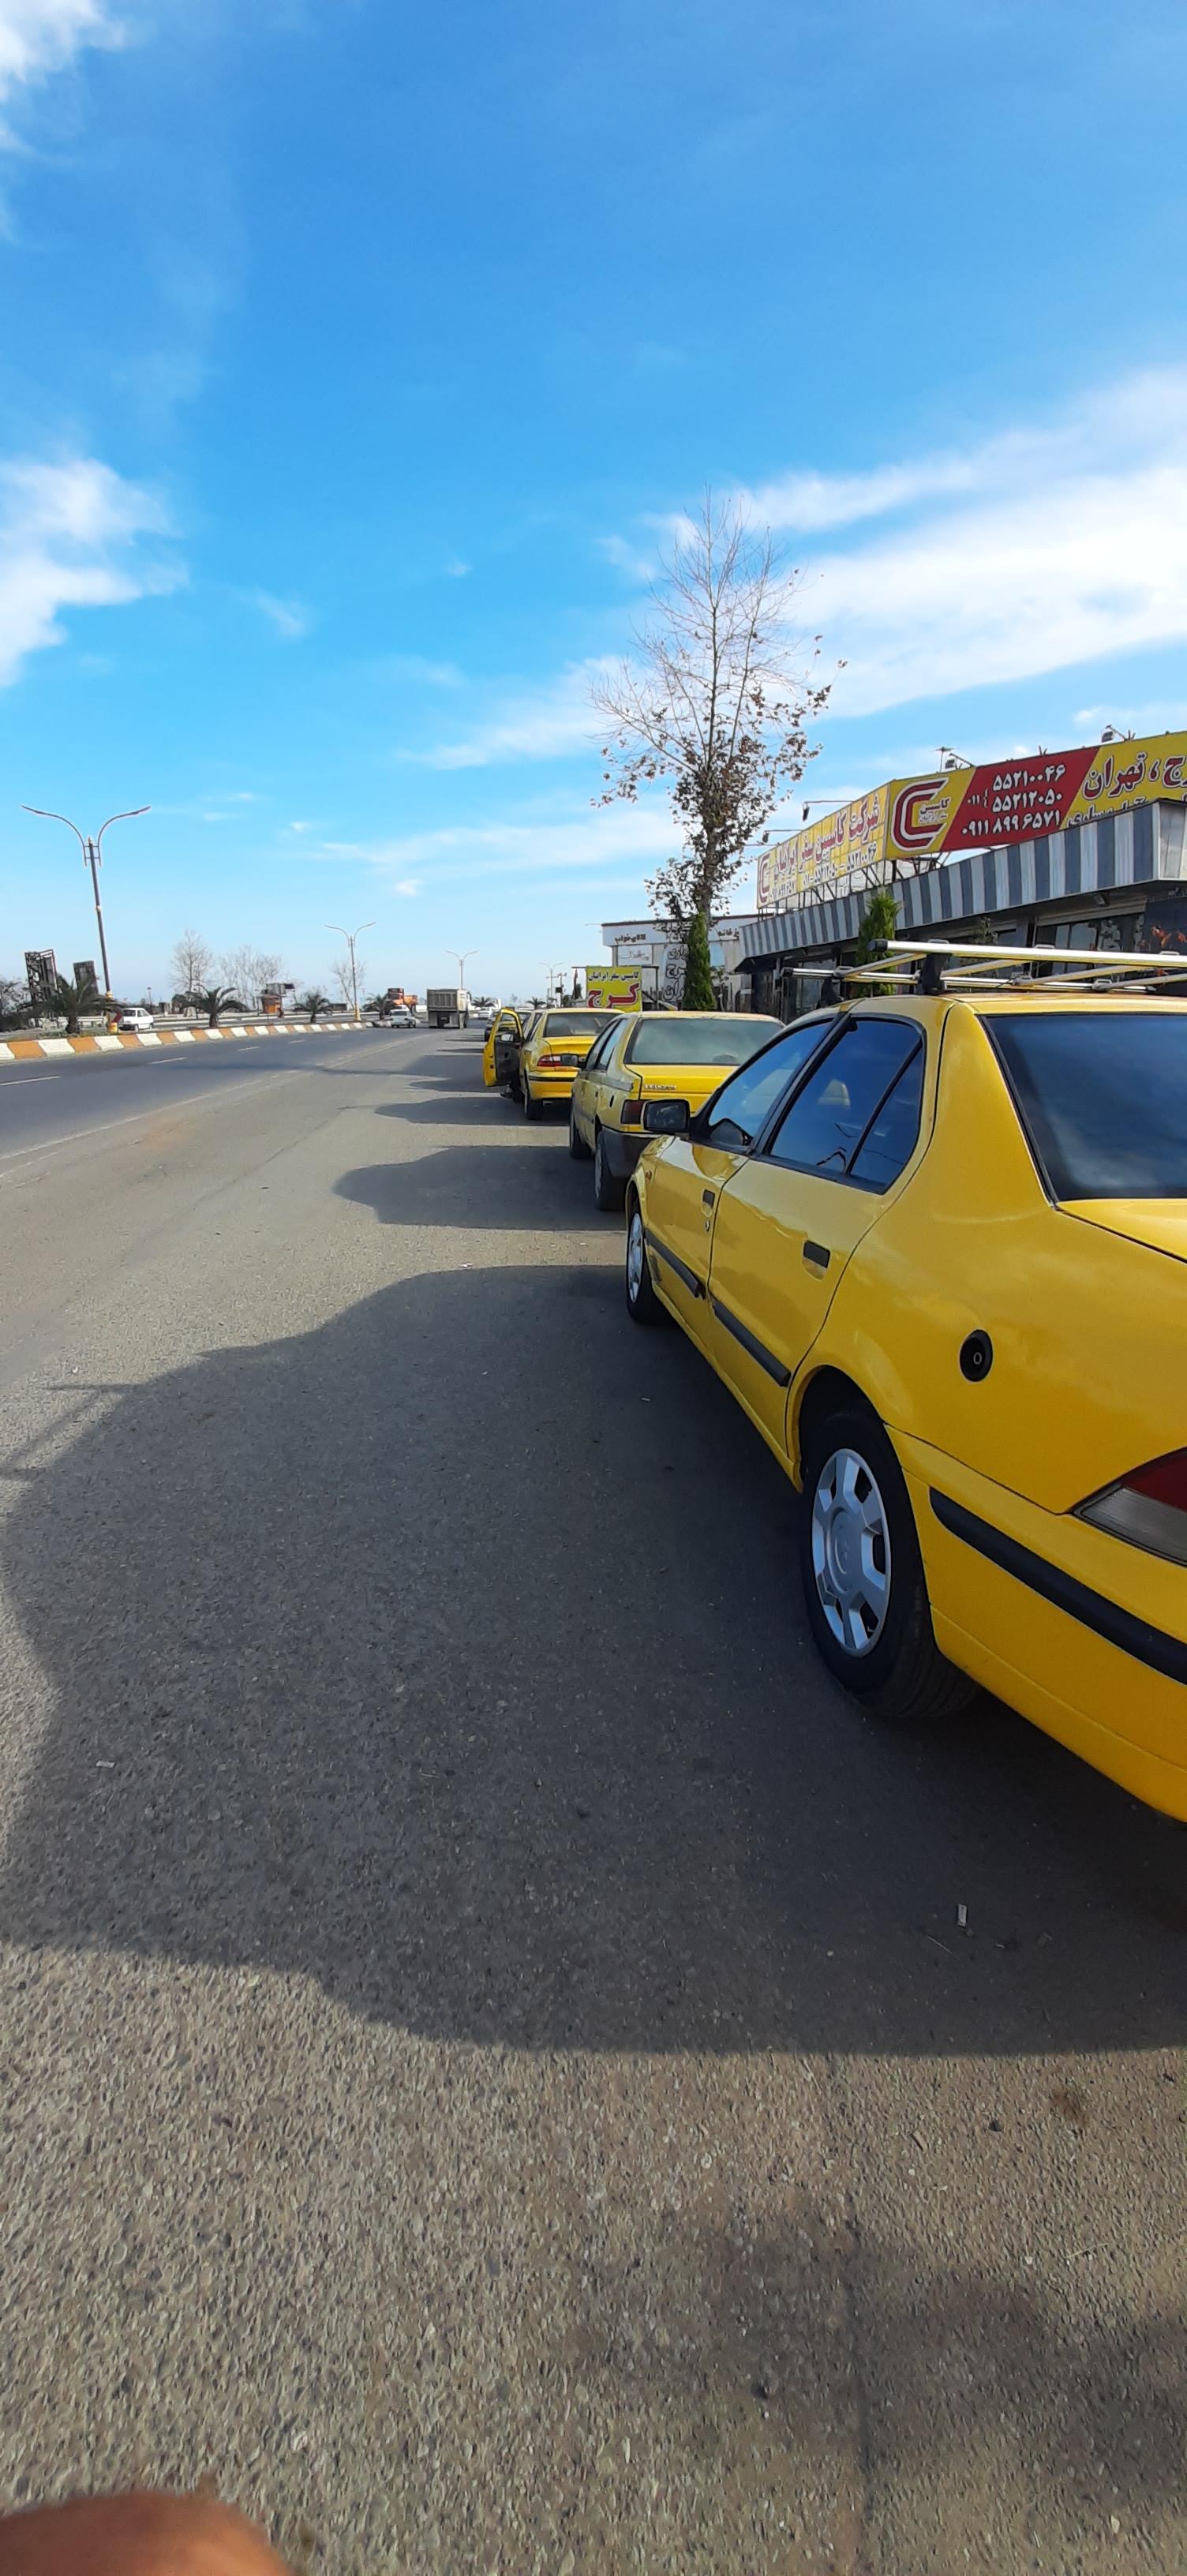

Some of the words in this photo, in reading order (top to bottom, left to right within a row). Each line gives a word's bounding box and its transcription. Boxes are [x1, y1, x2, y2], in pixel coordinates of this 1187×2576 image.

[993, 764, 1065, 792] ۵۵۲۱۰۰۴۶
[1083, 752, 1147, 799] تهران
[992, 788, 1062, 813] ۵۵۲۱۲۰۵۰
[848, 793, 880, 845] شرکت
[587, 983, 640, 1009] کرج
